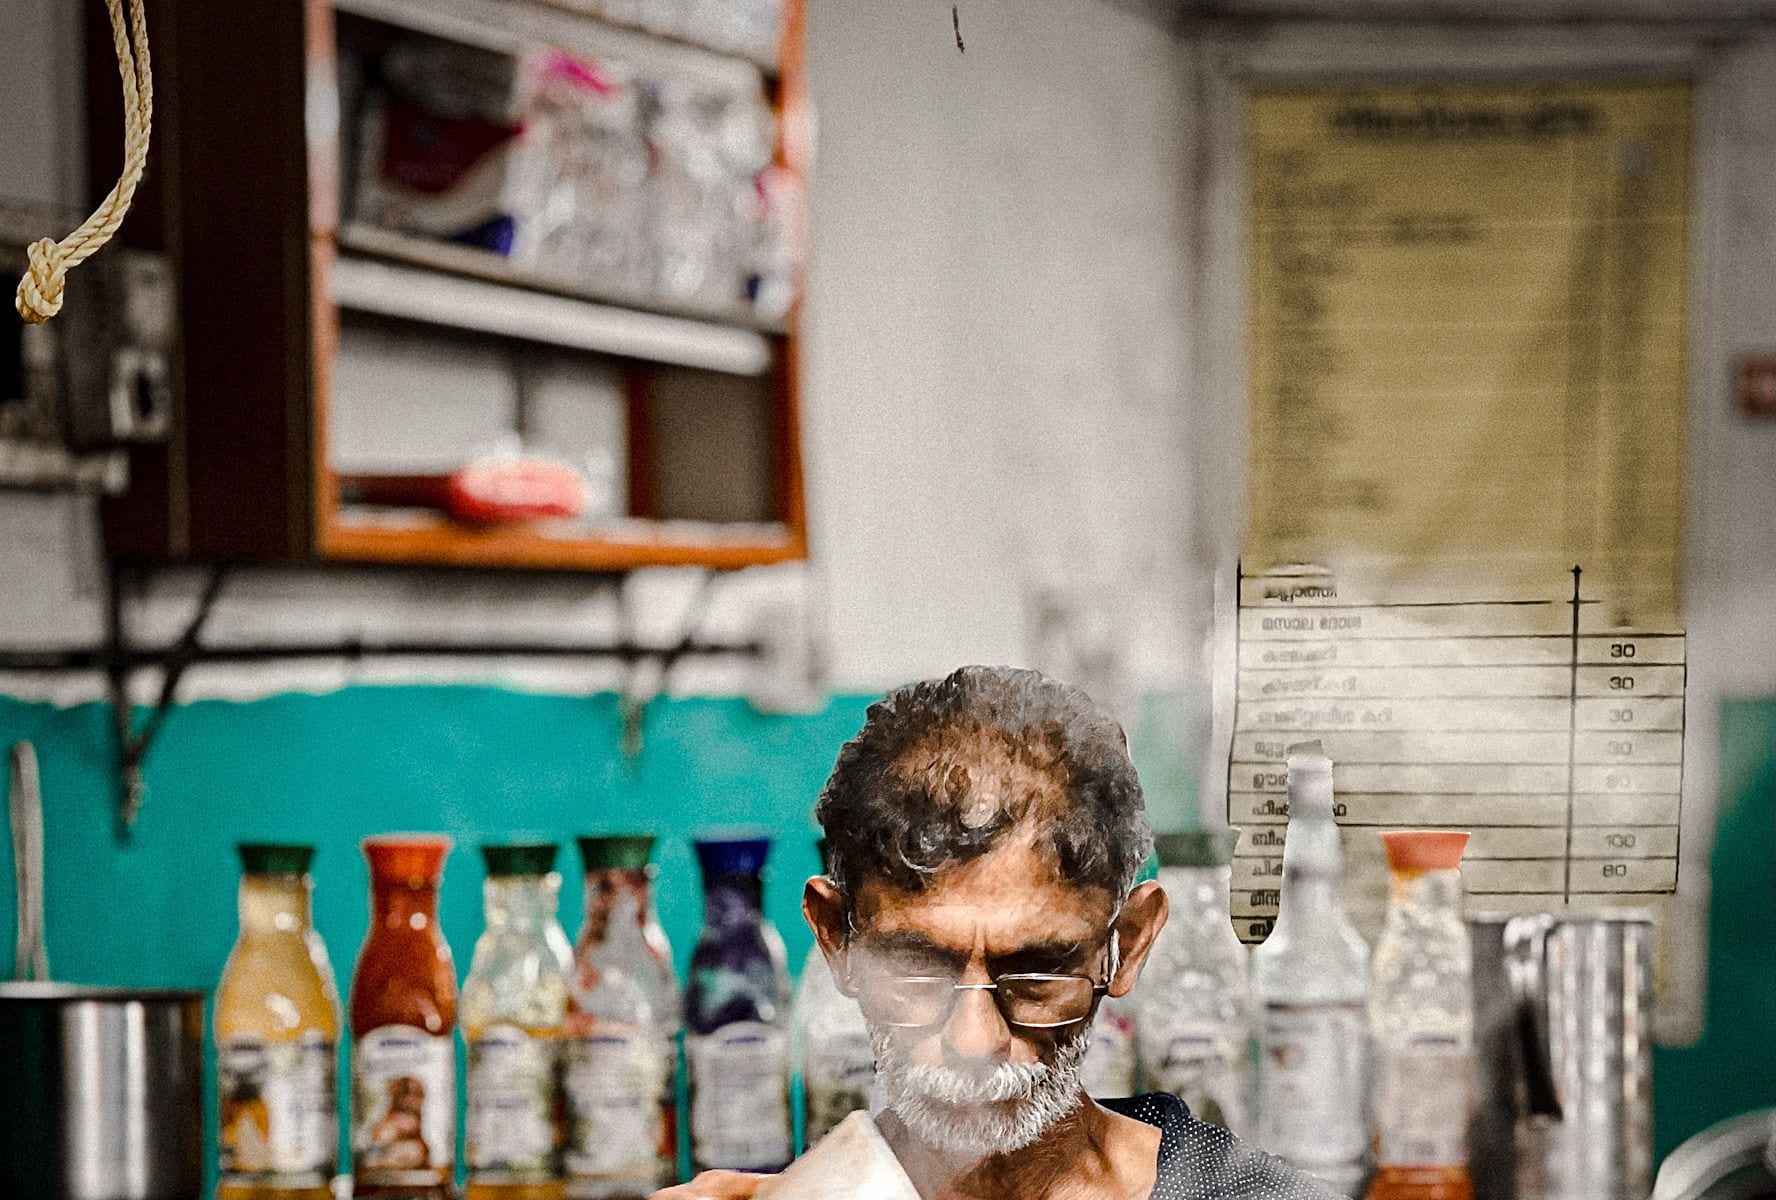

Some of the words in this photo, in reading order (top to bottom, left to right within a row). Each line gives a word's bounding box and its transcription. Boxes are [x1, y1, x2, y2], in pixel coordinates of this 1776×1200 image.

[1262, 615, 1314, 631] മസാല
[1610, 643, 1636, 659] 30
[1609, 676, 1635, 691] 30
[1608, 708, 1634, 723] 30
[1608, 740, 1633, 756] 30
[1605, 833, 1637, 849] 100
